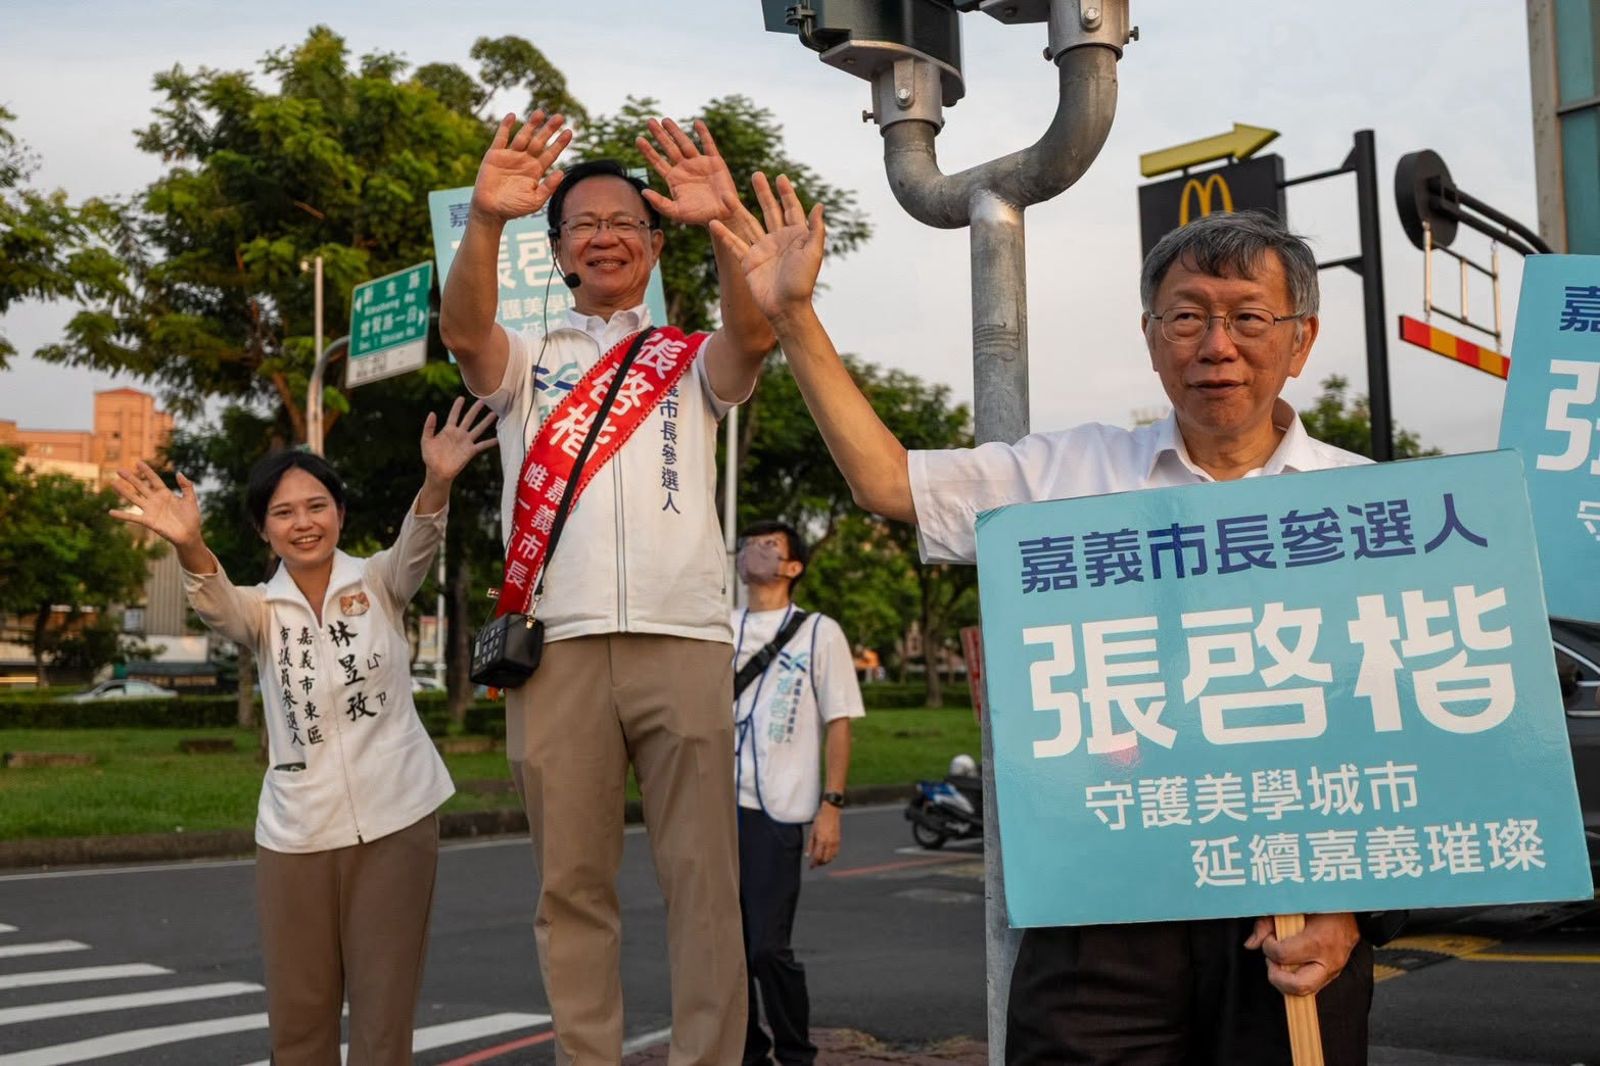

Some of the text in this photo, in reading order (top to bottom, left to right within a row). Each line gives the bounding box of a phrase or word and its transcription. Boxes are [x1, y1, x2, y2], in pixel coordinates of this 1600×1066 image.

[1019, 493, 1489, 594] 嘉義市長參選人
[297, 626, 324, 745] 嘉義市東區
[1085, 761, 1419, 831] 守護美學城市
[1190, 818, 1547, 888] 延續嘉義璀璨
